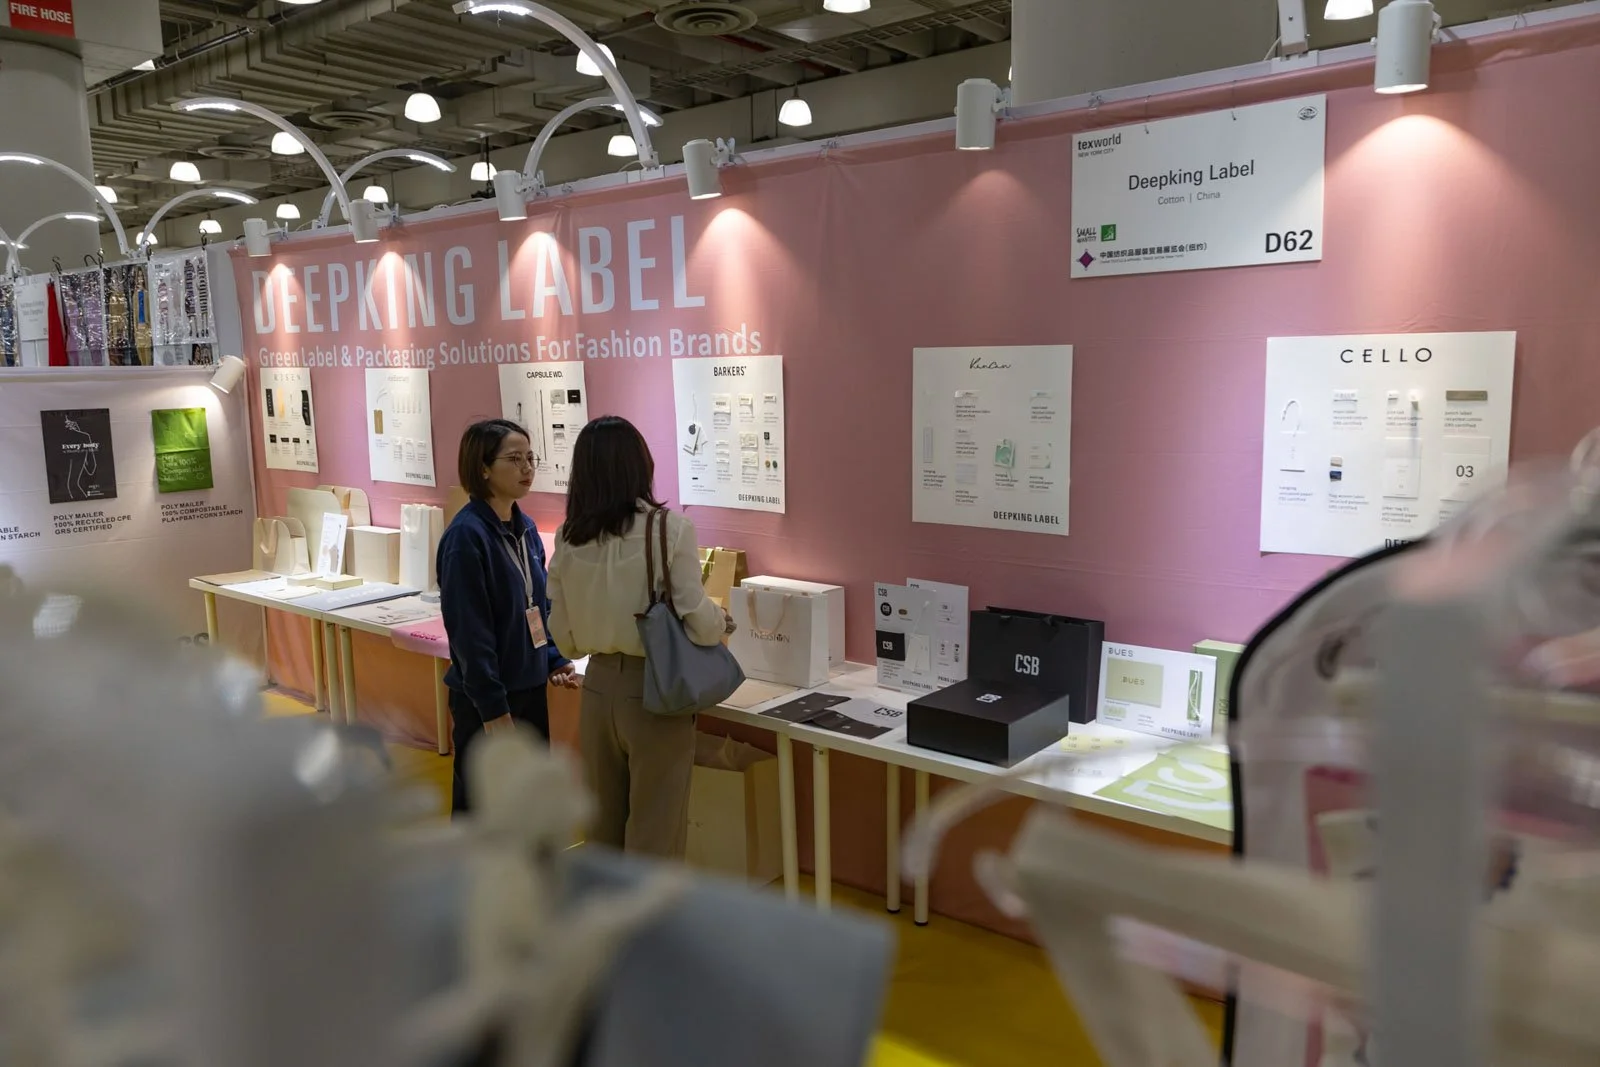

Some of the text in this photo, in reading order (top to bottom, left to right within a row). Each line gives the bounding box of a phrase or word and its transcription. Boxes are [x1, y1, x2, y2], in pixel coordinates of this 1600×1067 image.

[10, 2, 72, 24] FIRE HOSE
[1078, 132, 1122, 150] texworld
[1128, 160, 1254, 190] Deepking Label
[1158, 194, 1184, 205] Cotton
[1197, 190, 1220, 201] China
[1077, 227, 1097, 237] SMALL
[1264, 229, 1314, 254] D62
[252, 215, 706, 334] DEEPKING LABEL
[260, 323, 761, 370] Green Label & Packaging Solutions For Fashion Brands
[1340, 348, 1432, 364] CELLO
[1456, 465, 1474, 478] 03
[738, 494, 780, 504] DEEPKING LABEL
[179, 504, 227, 514] COMPOSTABLE
[75, 516, 116, 525] RECYCLED
[162, 512, 216, 523] PLA+PBAT+CORN
[993, 511, 1060, 524] DEEPKING LABEL
[72, 524, 112, 533] CERTIFIED
[878, 588, 888, 597] CSB
[882, 641, 893, 651] CSB
[1014, 653, 1040, 676] CSB
[874, 707, 903, 718] CSB
[1161, 726, 1186, 737] DEEPKING
